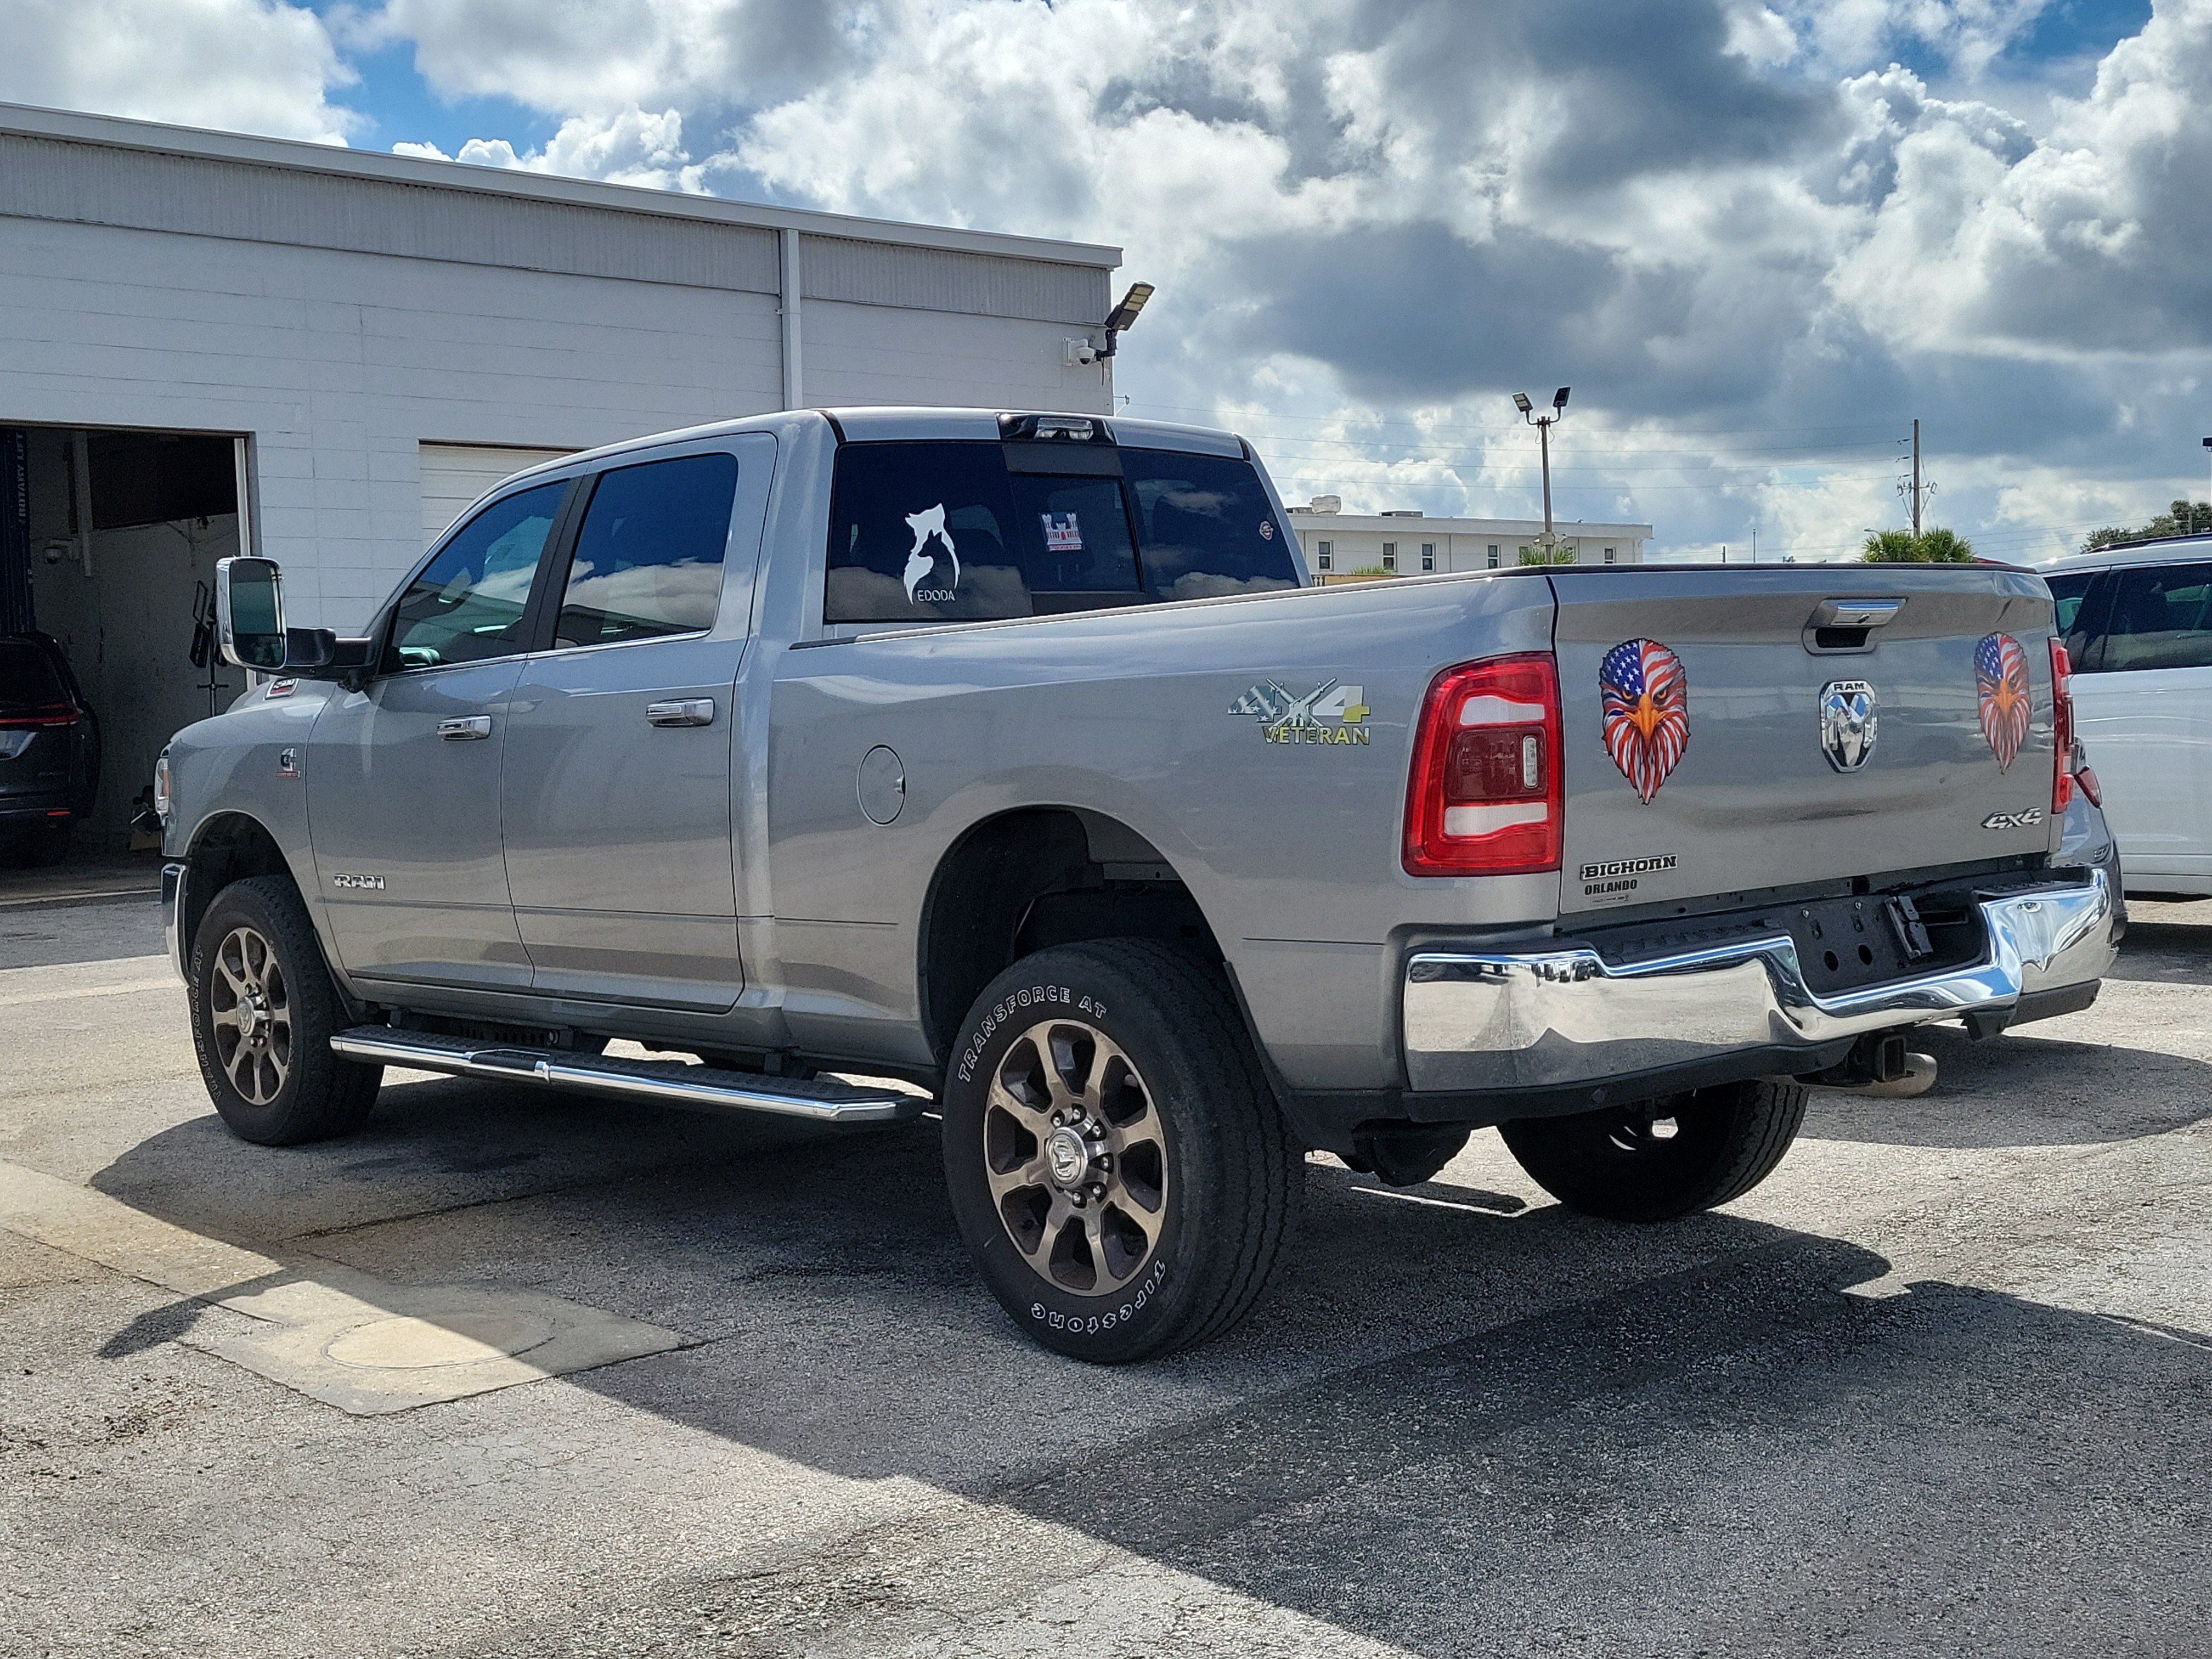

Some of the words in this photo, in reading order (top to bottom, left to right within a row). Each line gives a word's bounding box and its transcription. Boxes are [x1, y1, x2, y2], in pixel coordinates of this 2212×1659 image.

[917, 590, 955, 601] EDODA
[1833, 682, 1865, 691] RAM
[1262, 726, 1370, 745] VETERAN
[1582, 854, 1678, 880] BIGHORN
[334, 873, 385, 890] RAM
[1584, 879, 1638, 895] ORLANDO
[958, 985, 1070, 1082] TRANSFORCE
[1079, 996, 1107, 1019] AT
[1031, 1260, 1166, 1335] Firestone
